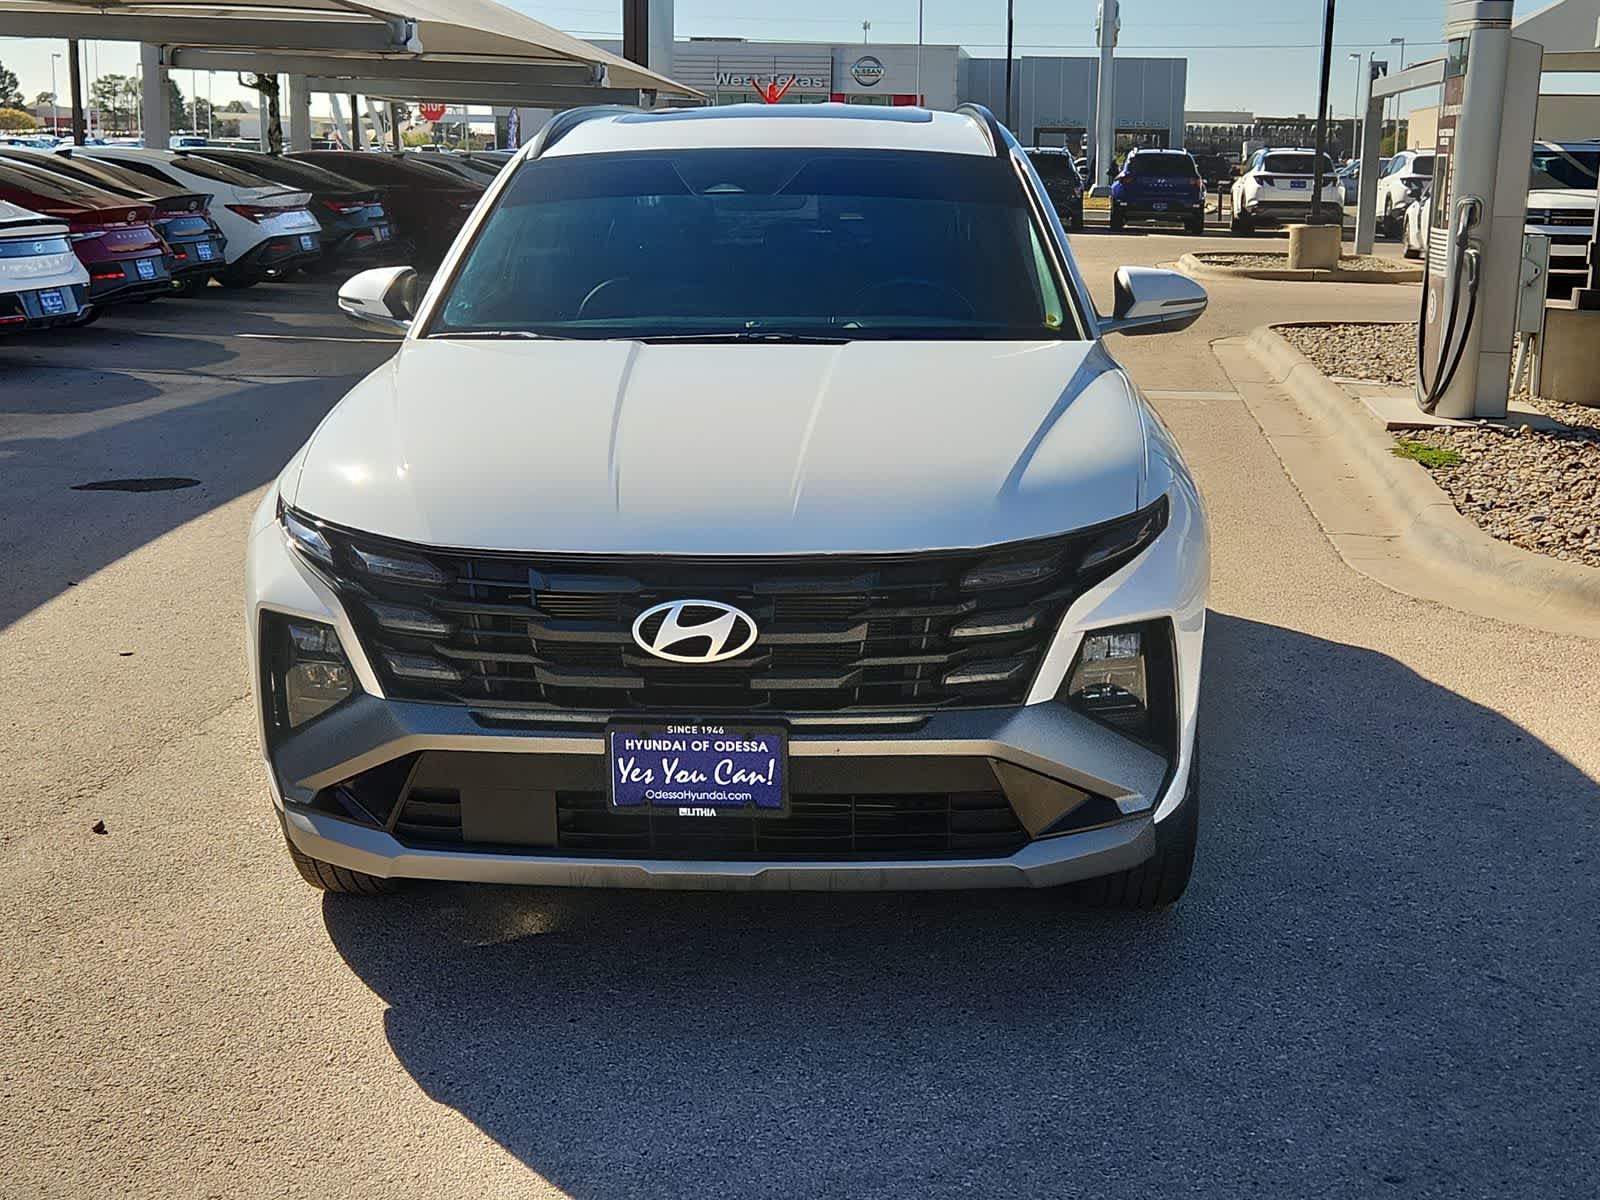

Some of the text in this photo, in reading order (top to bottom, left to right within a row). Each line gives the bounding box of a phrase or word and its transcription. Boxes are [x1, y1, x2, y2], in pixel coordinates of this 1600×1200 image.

[854, 67, 882, 75] NISSAN
[713, 72, 824, 87] West Texas
[667, 725, 725, 735] SINCE 1946
[625, 739, 769, 753] HYUNDAI OF ODESSA
[617, 756, 776, 785] Yes You Can!
[645, 789, 752, 802] OdessaHyundai.com
[687, 807, 717, 817] LITHIA
